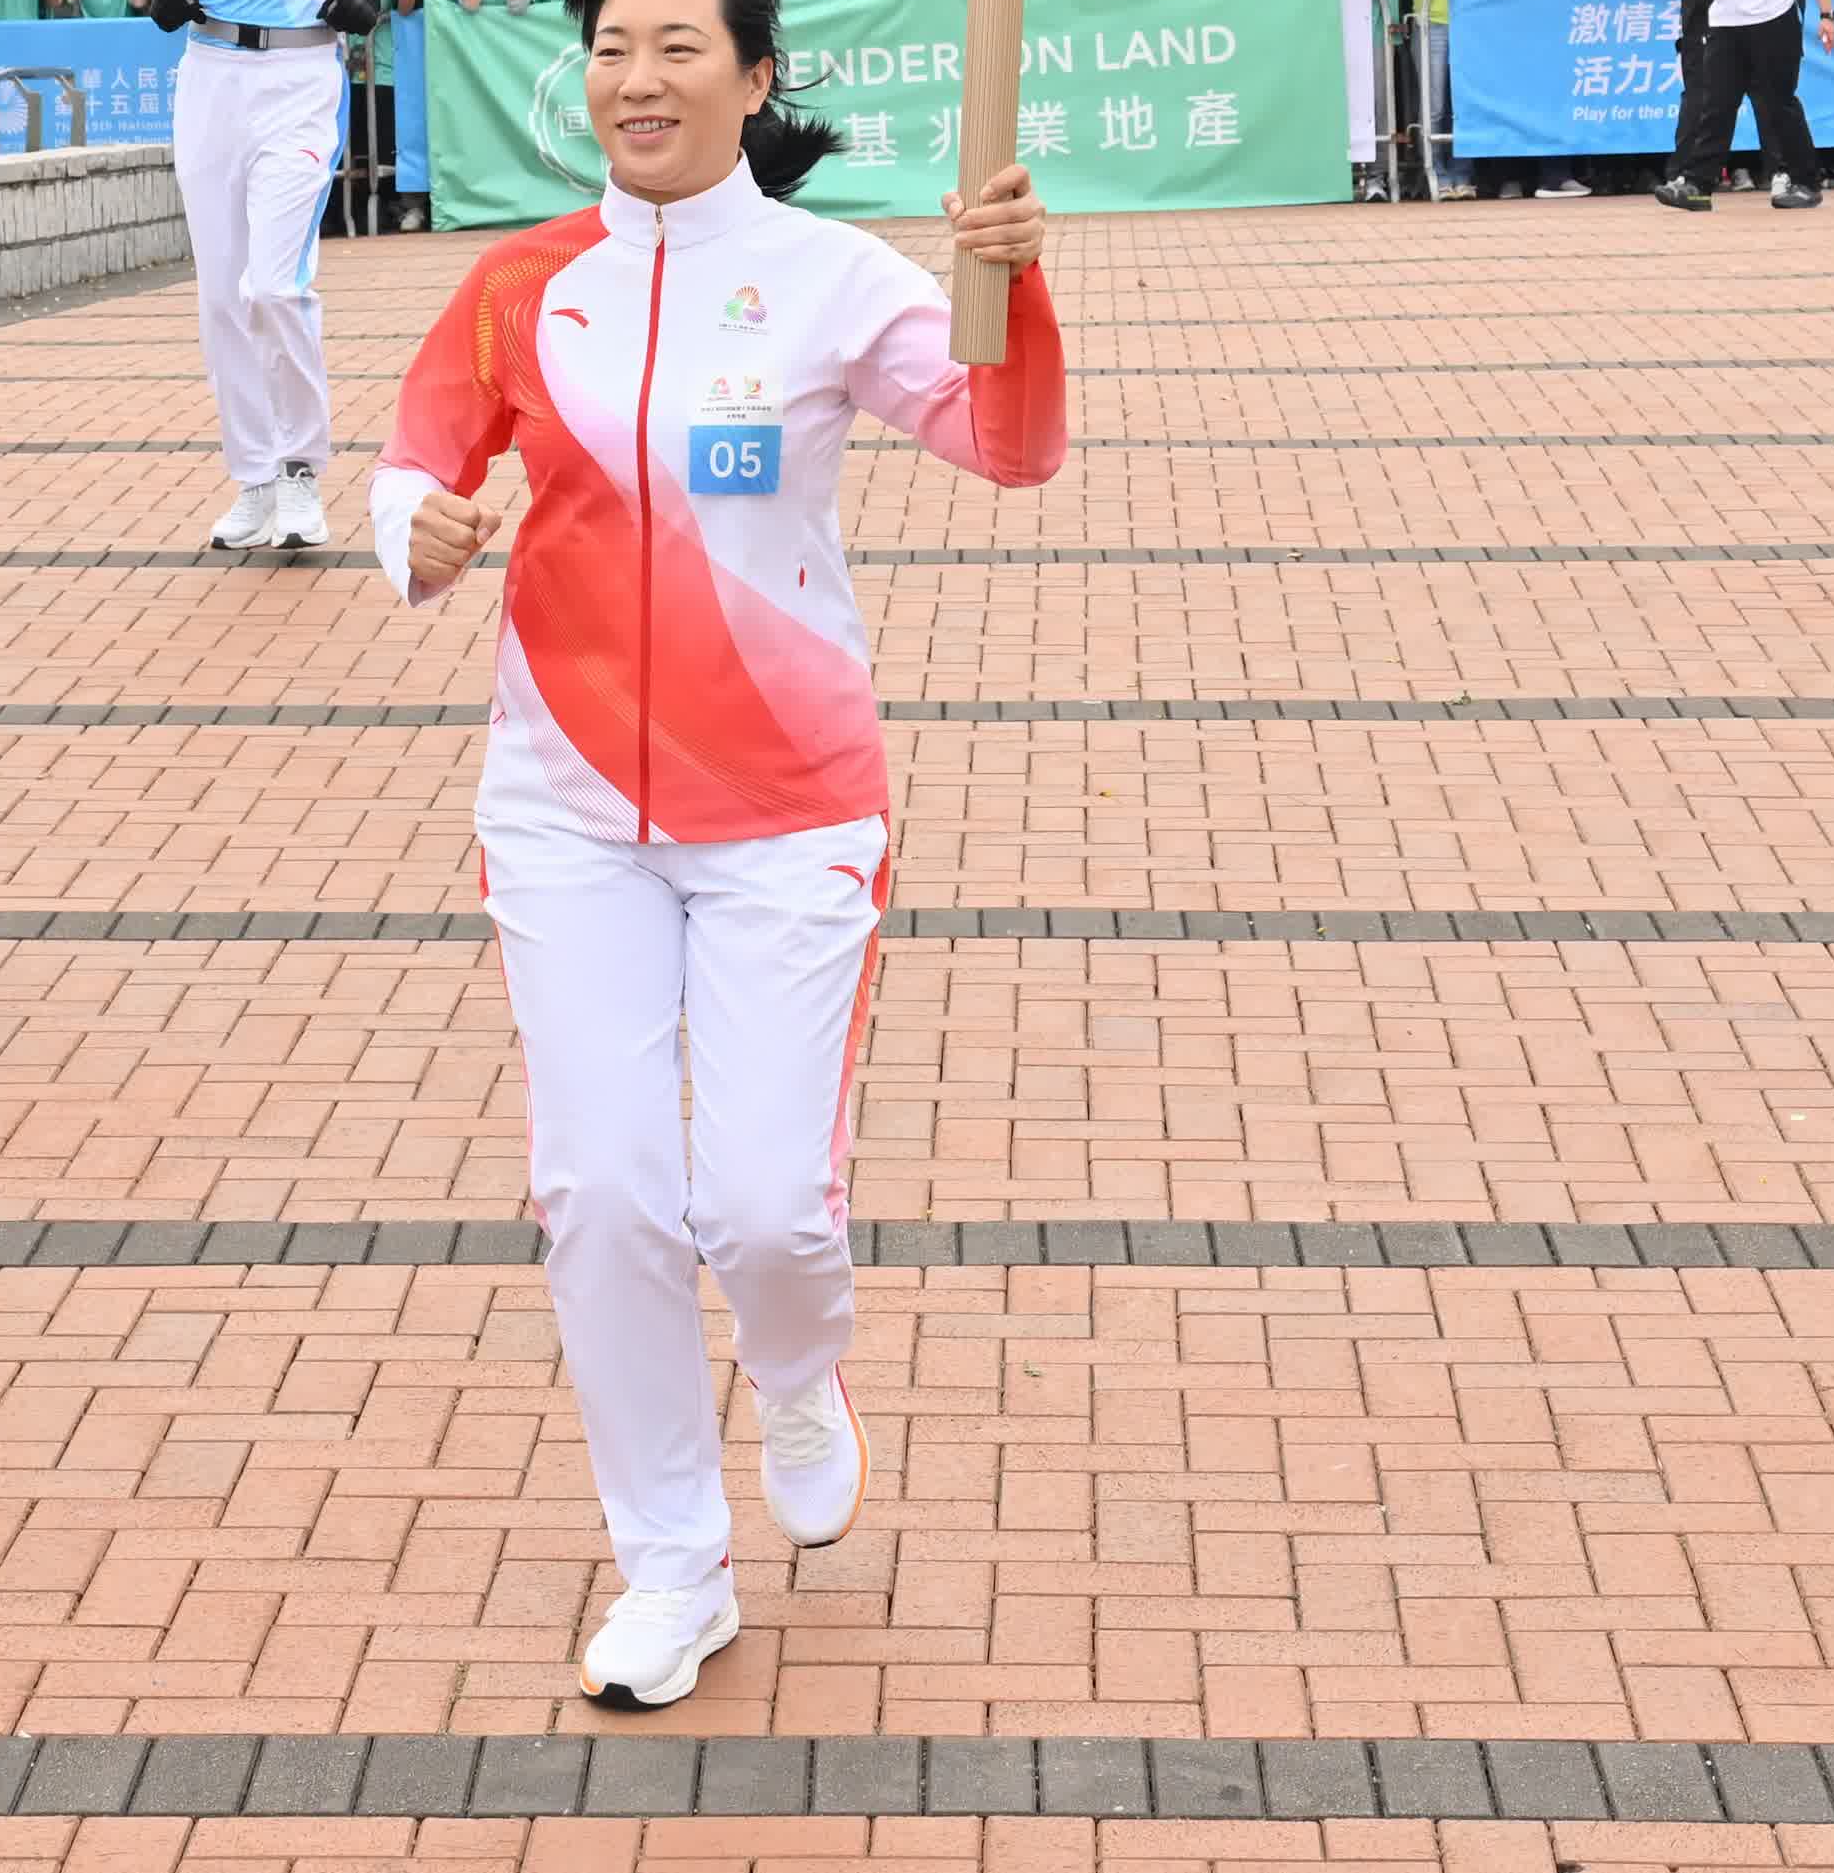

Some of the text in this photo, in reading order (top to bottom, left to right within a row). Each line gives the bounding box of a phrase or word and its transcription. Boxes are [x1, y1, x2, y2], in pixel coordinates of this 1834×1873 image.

[785, 25, 1236, 89] ENDERN LAND
[840, 88, 1243, 168] 基兆業地產
[1573, 107, 1607, 123] Play
[1612, 105, 1633, 121] for
[1638, 104, 1664, 120] the
[709, 440, 762, 479] 05
